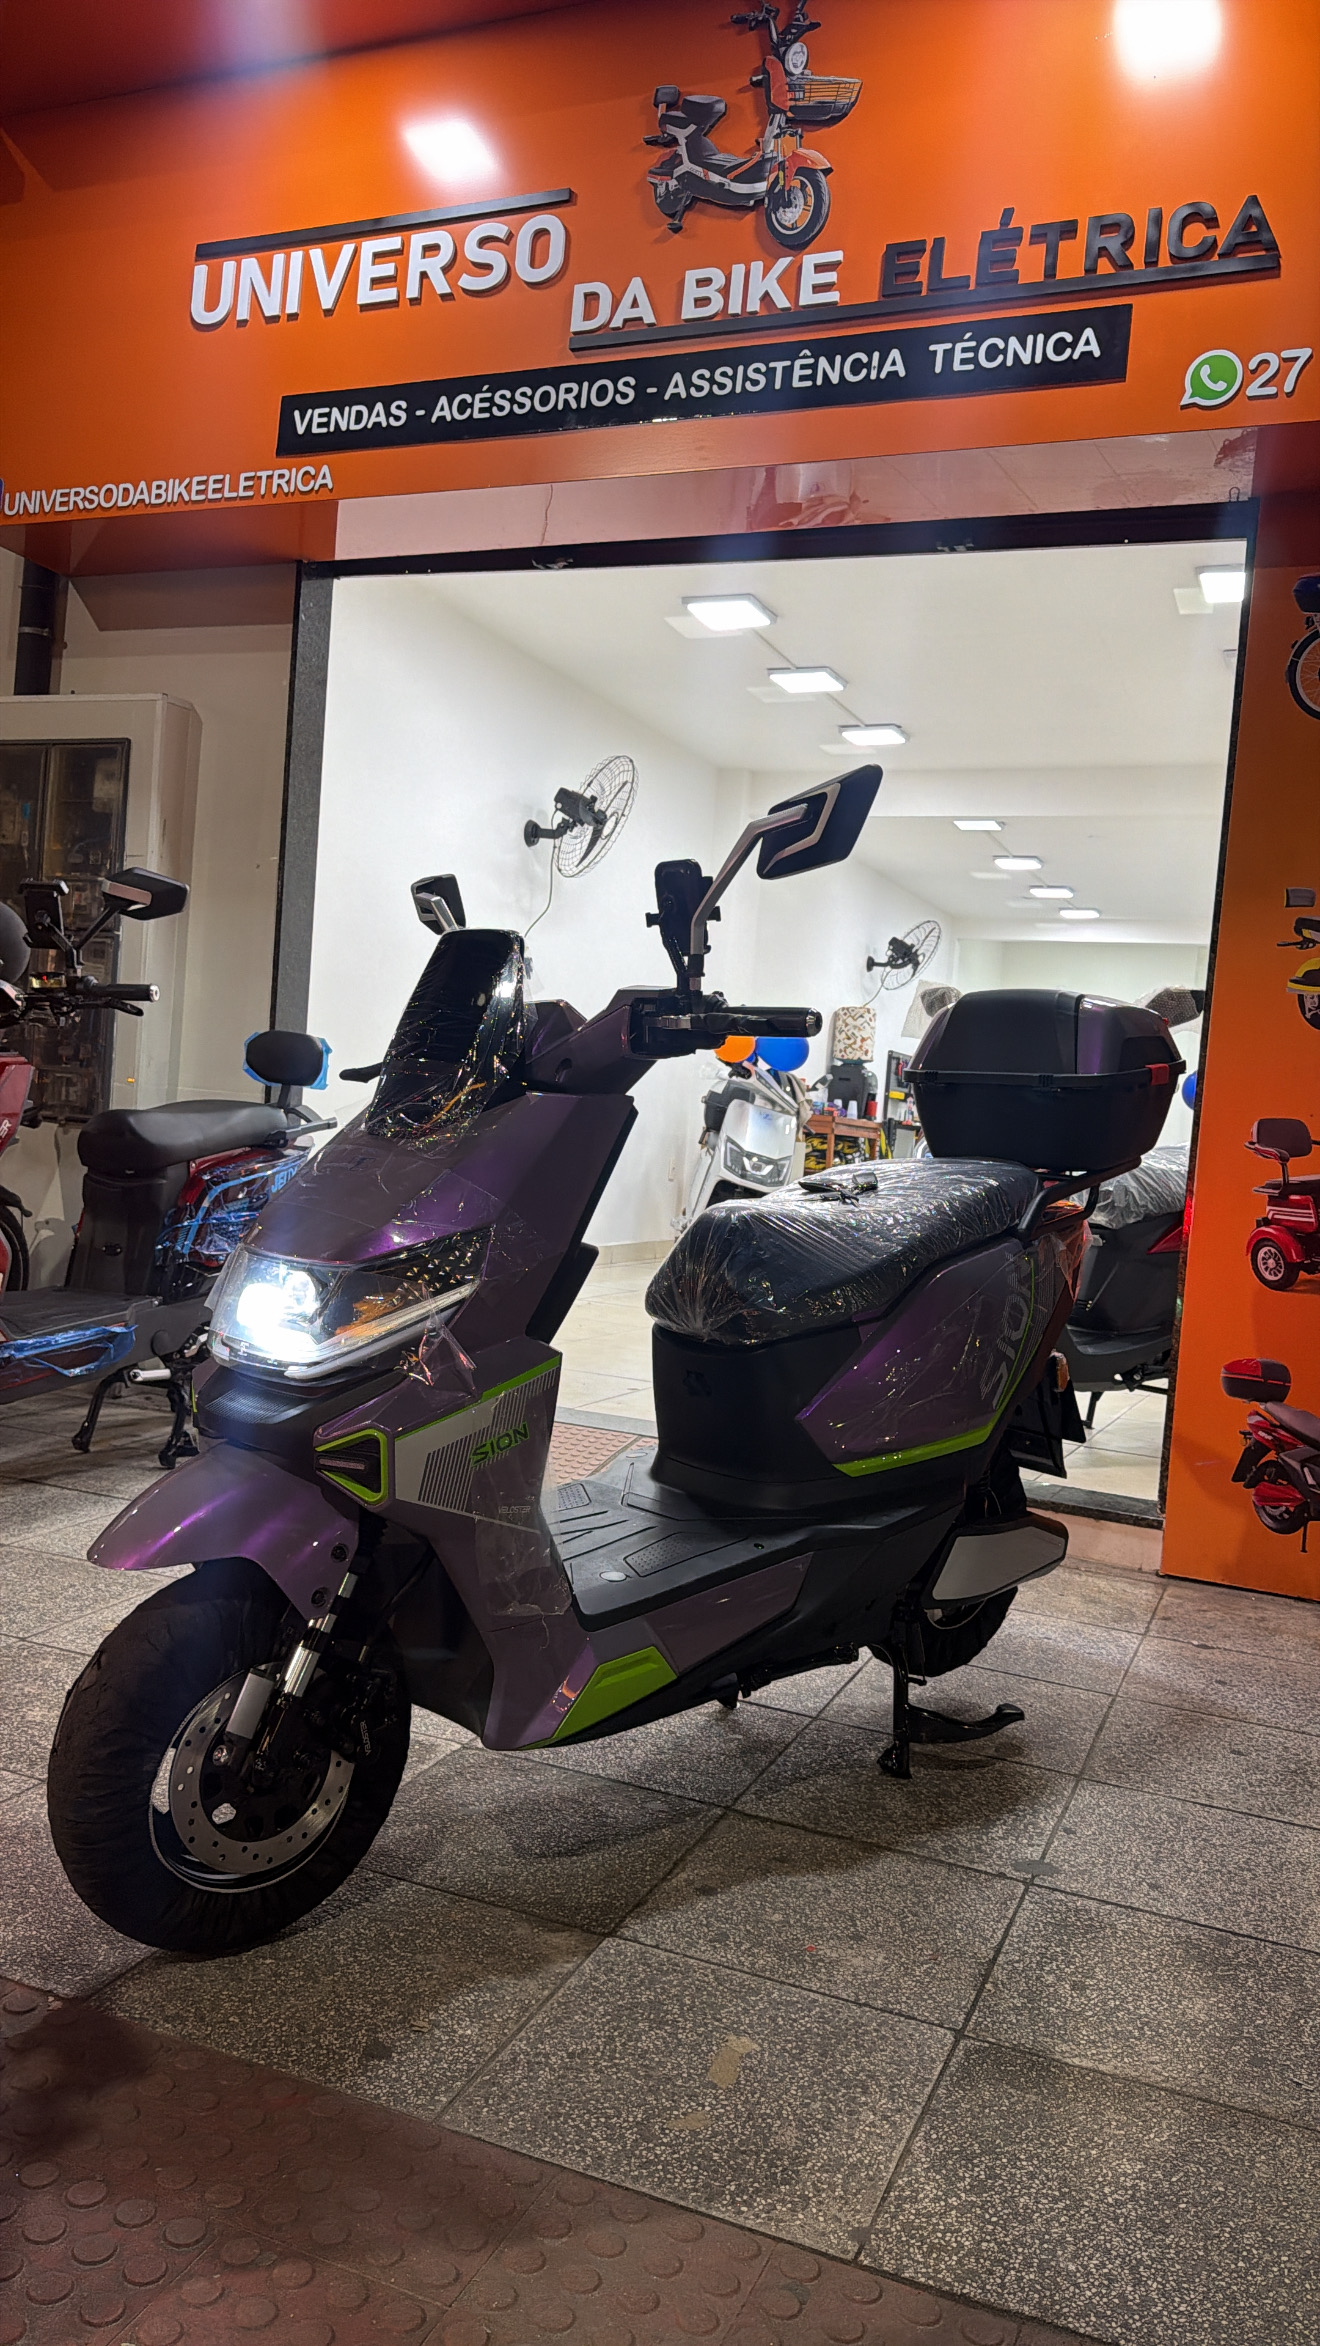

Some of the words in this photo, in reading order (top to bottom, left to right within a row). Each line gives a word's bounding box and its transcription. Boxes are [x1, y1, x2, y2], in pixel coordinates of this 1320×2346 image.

[191, 214, 567, 326] UNIVERSO
[570, 276, 657, 335] DA
[681, 250, 844, 322] BIKE
[881, 194, 1280, 299] ELÉTRICA
[294, 400, 408, 435] VENDAS
[431, 376, 637, 424] ACÉSSORIOS
[663, 348, 907, 400] ASSISTÊNCIA
[929, 327, 1101, 374] TÉCNICA
[1245, 347, 1314, 399] 27
[3, 464, 334, 516] UNIVERSODABIKEELETRICA
[469, 1421, 530, 1467] SION
